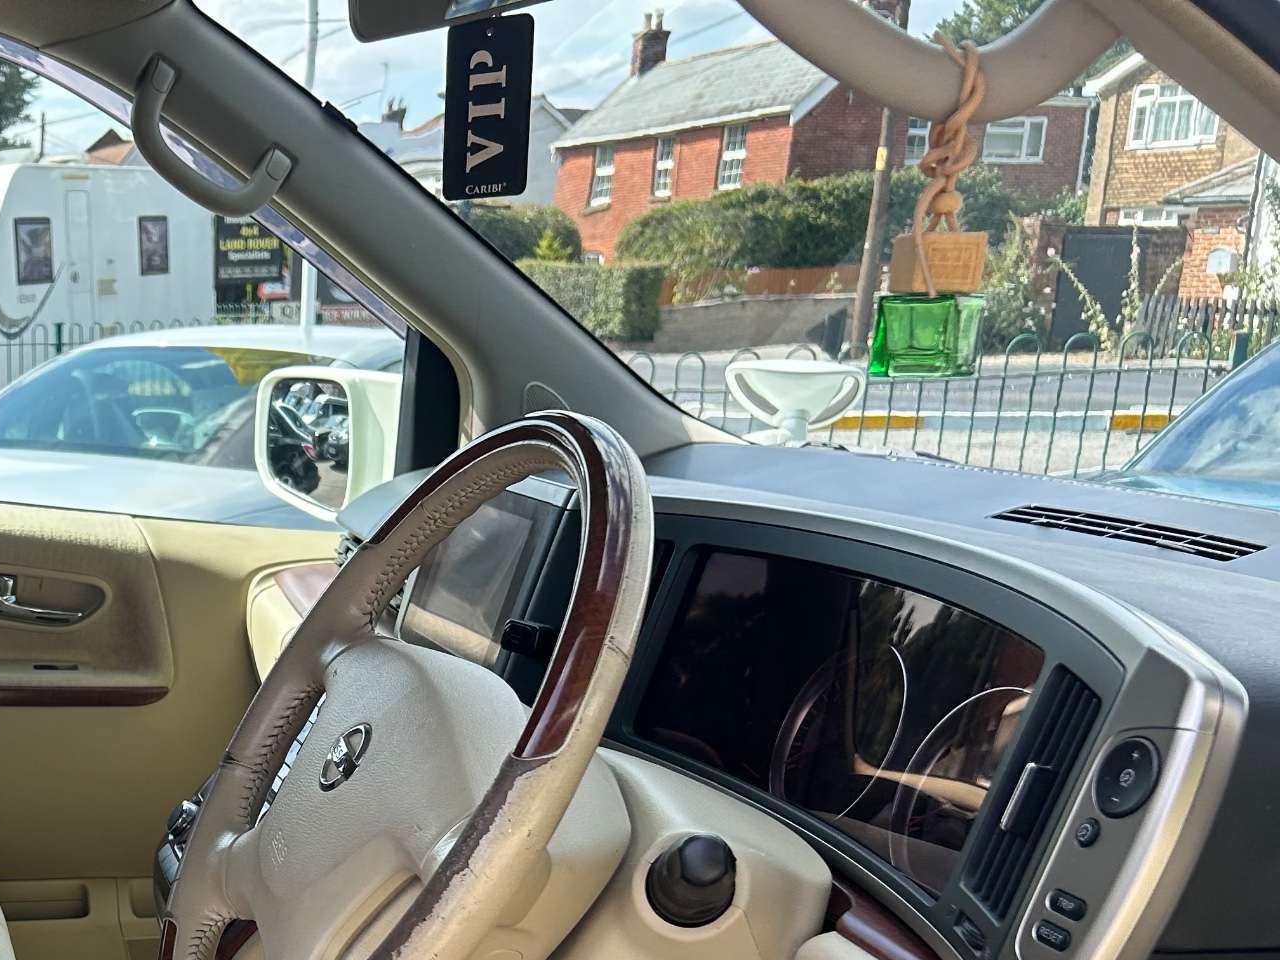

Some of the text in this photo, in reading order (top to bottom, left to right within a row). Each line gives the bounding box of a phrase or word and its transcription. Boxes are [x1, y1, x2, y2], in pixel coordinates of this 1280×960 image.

[466, 50, 507, 174] VIP
[465, 183, 504, 195] CARIBI
[1056, 896, 1075, 910] TRIP
[1039, 925, 1064, 944] RESET
